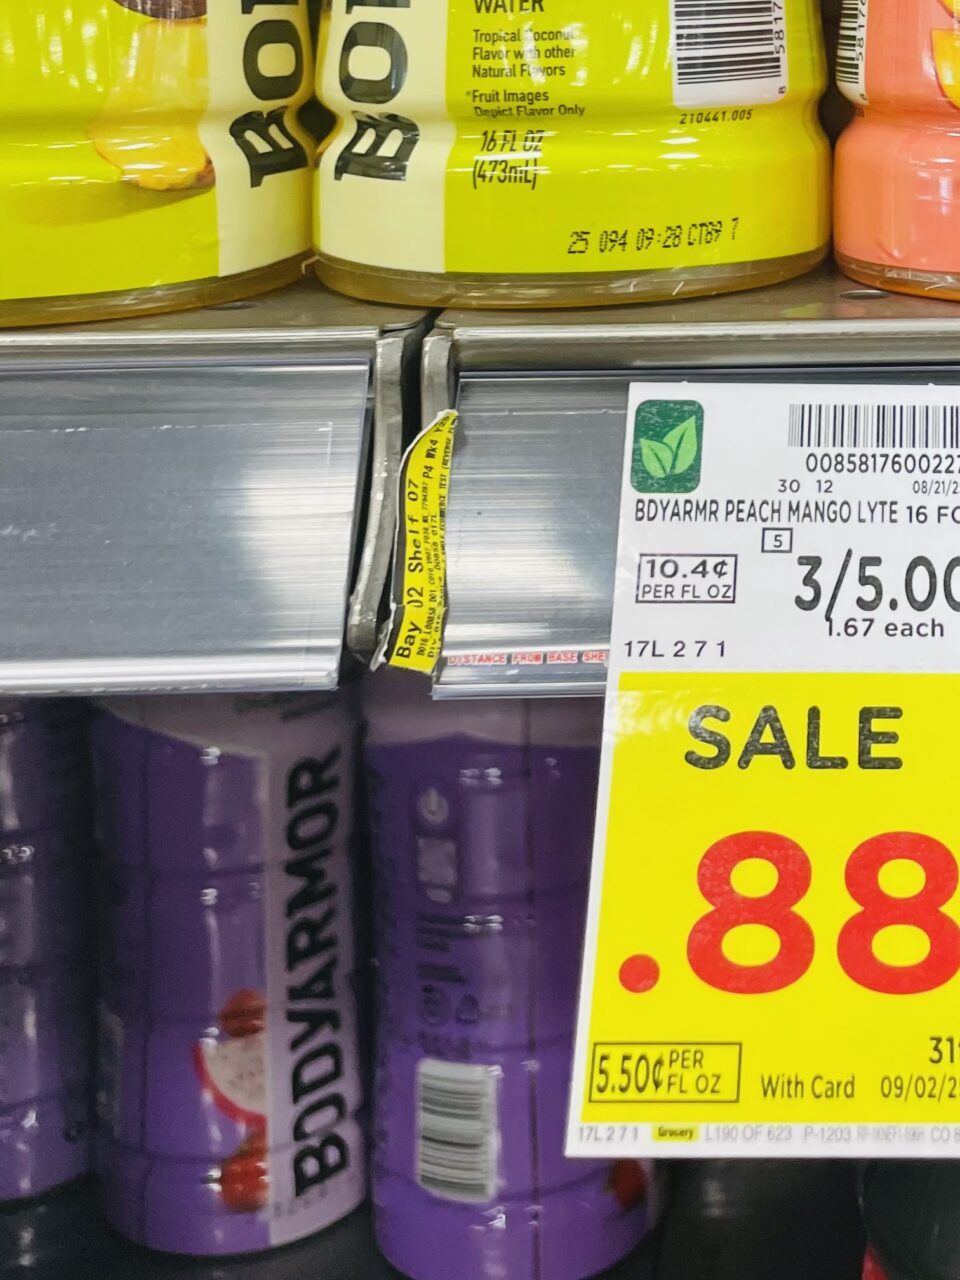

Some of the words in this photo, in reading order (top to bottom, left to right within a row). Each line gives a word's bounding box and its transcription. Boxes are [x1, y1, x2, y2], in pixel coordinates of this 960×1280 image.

[473, 29, 521, 45] Tropical
[473, 47, 510, 60] Flavor
[545, 46, 575, 58] other
[473, 65, 516, 78] Natural
[504, 90, 550, 105] Images
[558, 104, 585, 116] Only
[481, 130, 497, 152] 16
[500, 130, 517, 152] FL
[567, 231, 591, 254] 25
[408, 479, 419, 502] 07
[778, 479, 800, 493] 30
[816, 479, 834, 493] 12
[634, 498, 719, 522] BDYARMR
[725, 499, 781, 523] PEACH
[787, 500, 851, 524] MANGO
[857, 500, 898, 524] LYTE
[906, 506, 927, 524] 16
[407, 514, 424, 573] Shelf
[645, 558, 729, 579] 10.4¢
[641, 584, 675, 599] PER
[681, 584, 701, 599] FL
[708, 584, 732, 599] OZ
[825, 618, 875, 637] 1.67
[884, 619, 945, 637] each
[396, 621, 423, 658] Bay
[624, 640, 665, 658] 17L
[673, 641, 685, 658] 2
[695, 641, 708, 658] 7
[718, 641, 726, 658] 1
[548, 652, 577, 662] BASE
[683, 704, 904, 770] SALE
[284, 745, 352, 1199] BODYARMOR
[596, 1053, 665, 1094] 5.50¢
[668, 1049, 705, 1069] PER
[667, 1074, 688, 1094] FL
[695, 1074, 722, 1094] OZ
[760, 1074, 804, 1099] With
[811, 1074, 855, 1099] Card
[578, 1127, 601, 1142] 17L
[658, 1128, 694, 1141] Grocery
[705, 1127, 738, 1143] L190
[742, 1126, 764, 1143] OF
[767, 1125, 793, 1143] 623
